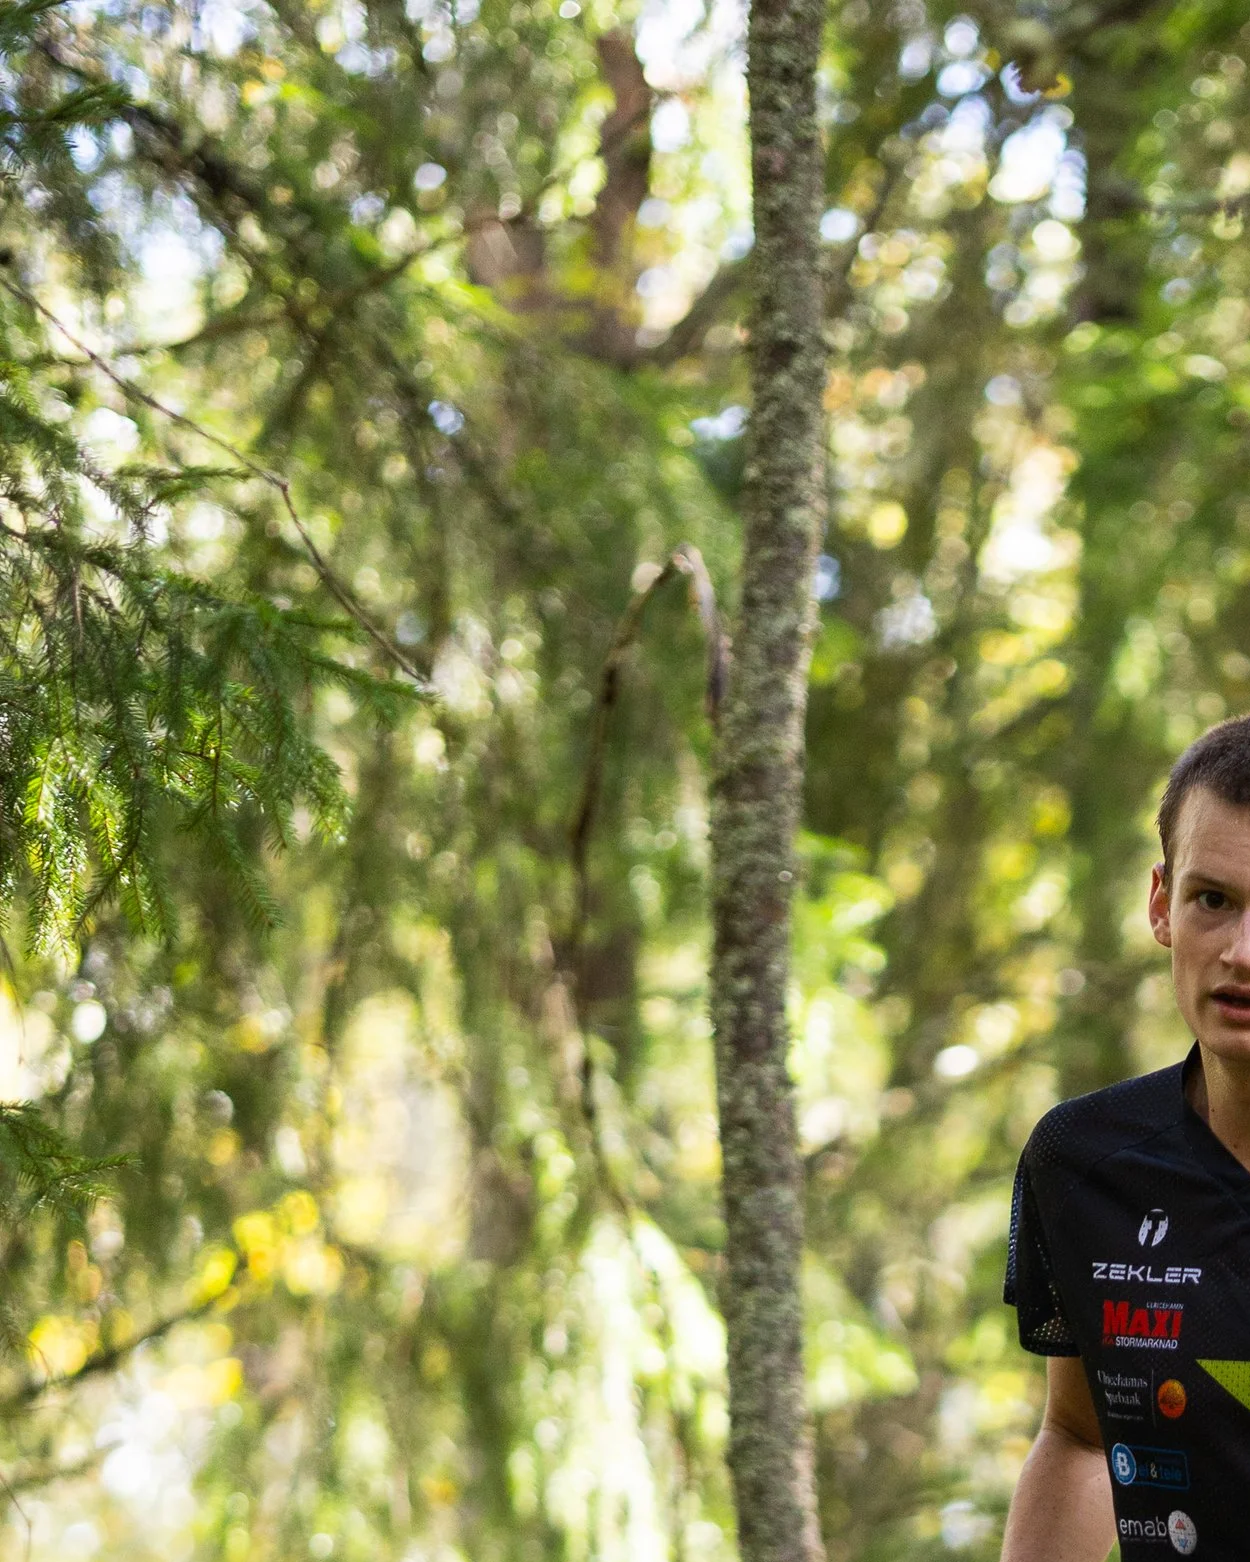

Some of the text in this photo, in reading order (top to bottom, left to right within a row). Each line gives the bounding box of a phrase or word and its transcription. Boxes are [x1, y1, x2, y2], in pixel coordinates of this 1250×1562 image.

[1092, 1262, 1202, 1284] ZEKLER
[1103, 1300, 1183, 1338] MAXI
[1115, 1336, 1178, 1349] STORMARKNAD
[1119, 1516, 1167, 1537] emab
